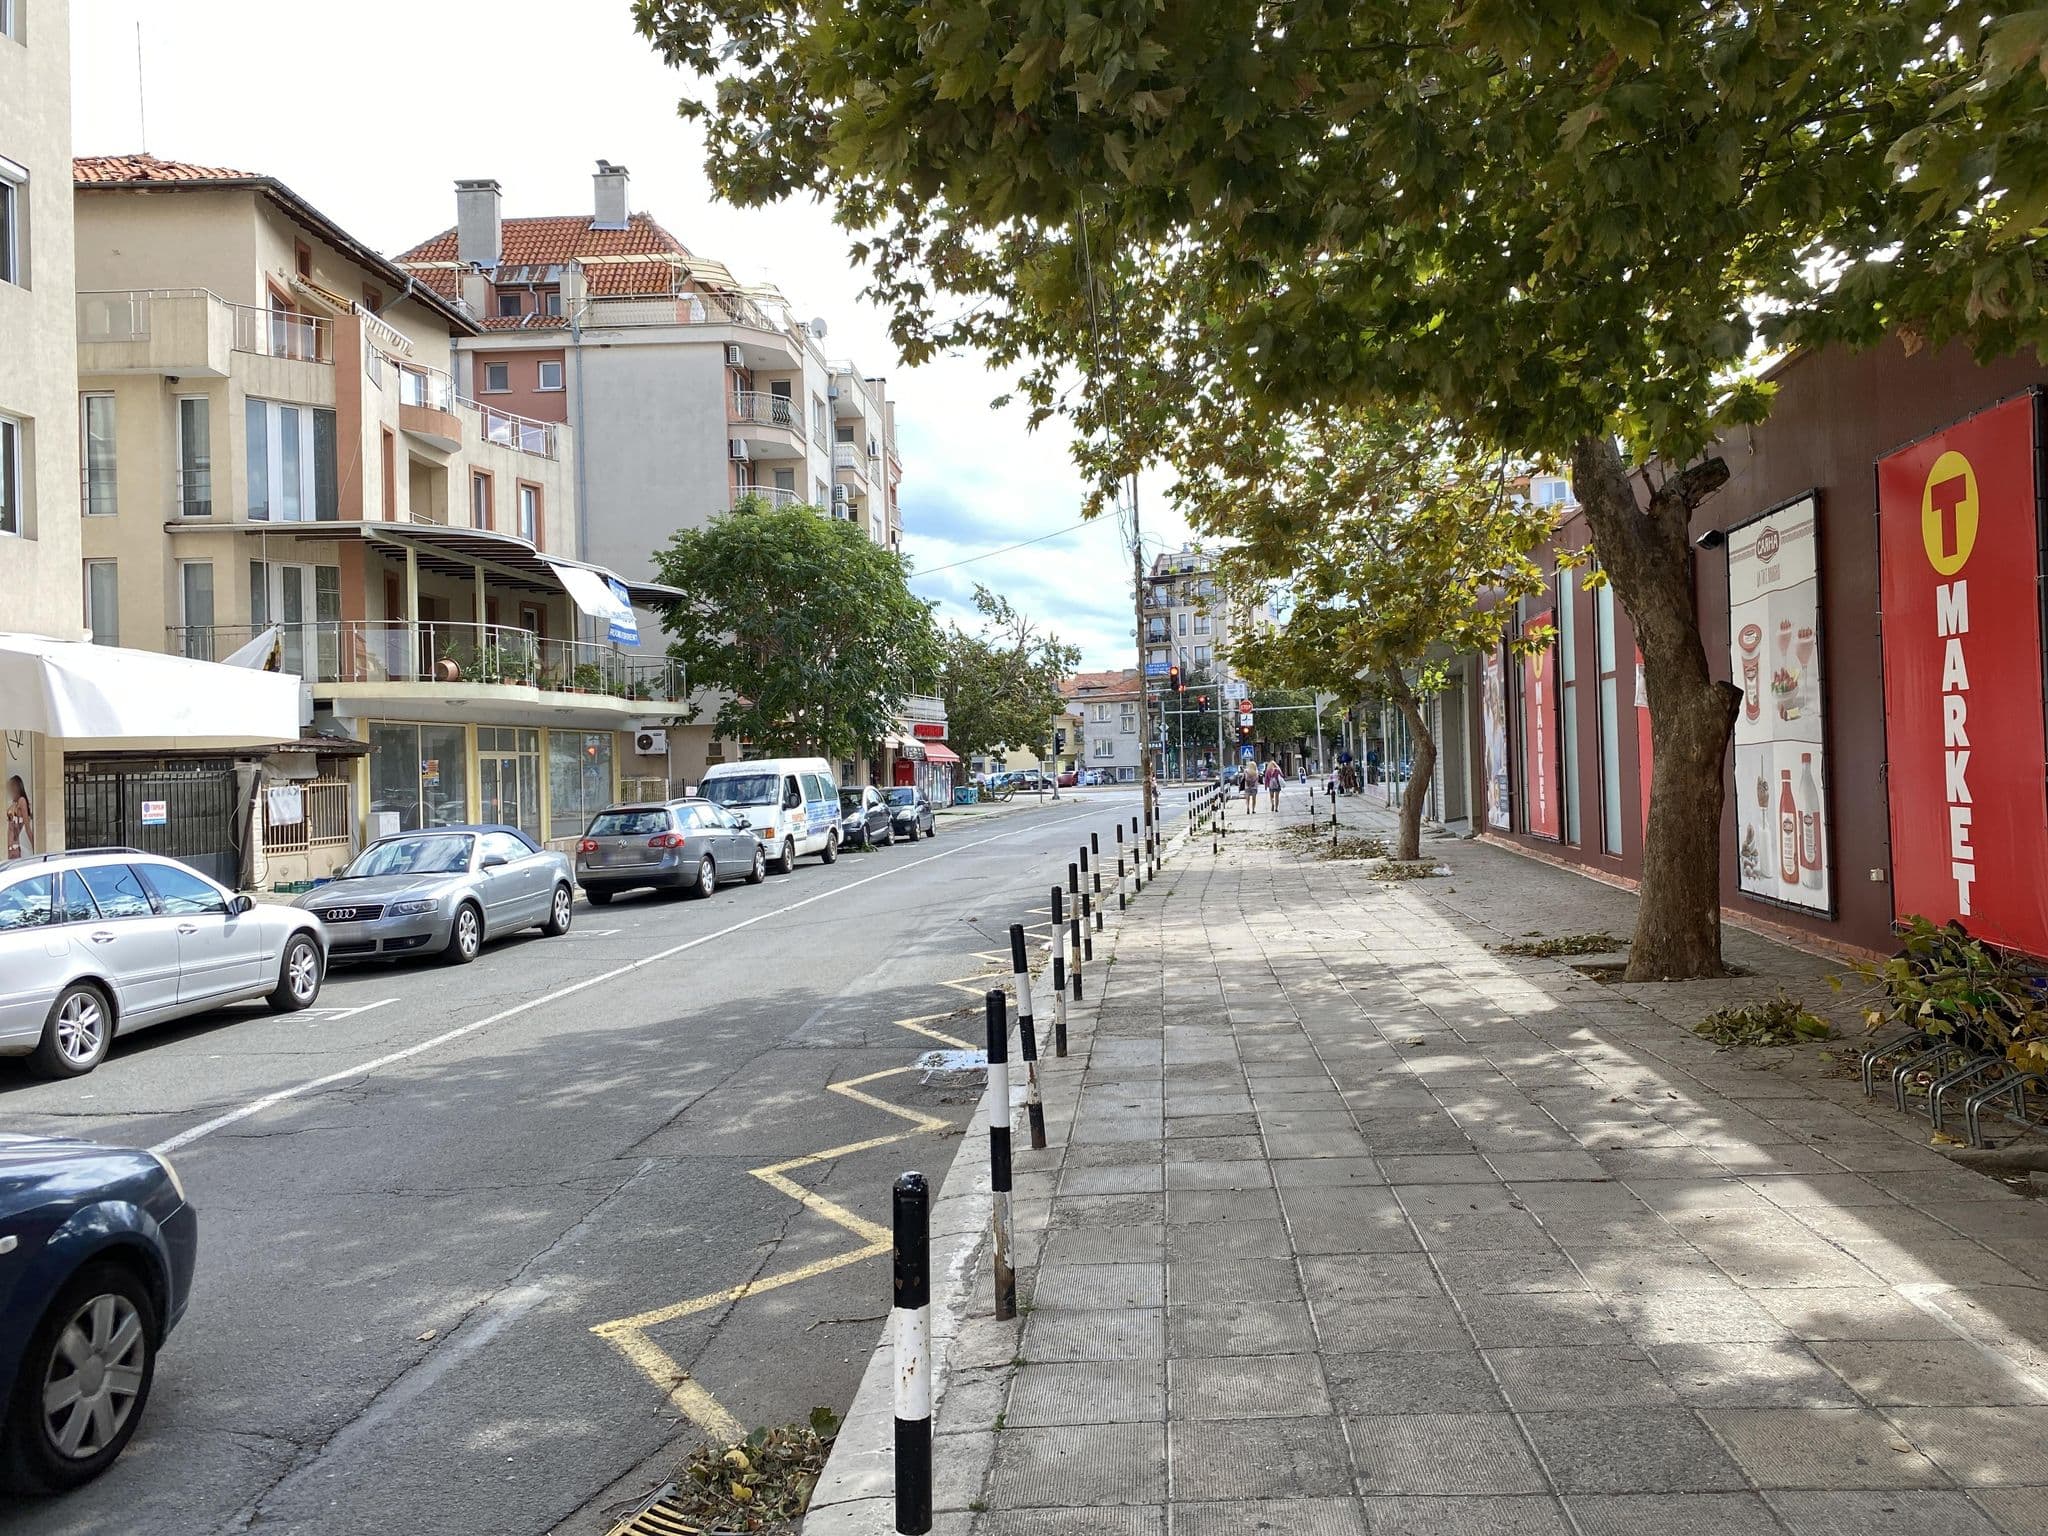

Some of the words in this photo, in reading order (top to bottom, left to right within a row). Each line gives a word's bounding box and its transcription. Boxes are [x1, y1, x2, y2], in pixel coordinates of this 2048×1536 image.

[1930, 473, 1967, 558] T
[1535, 681, 1546, 824] MARKET
[1936, 579, 1976, 916] MARKET
